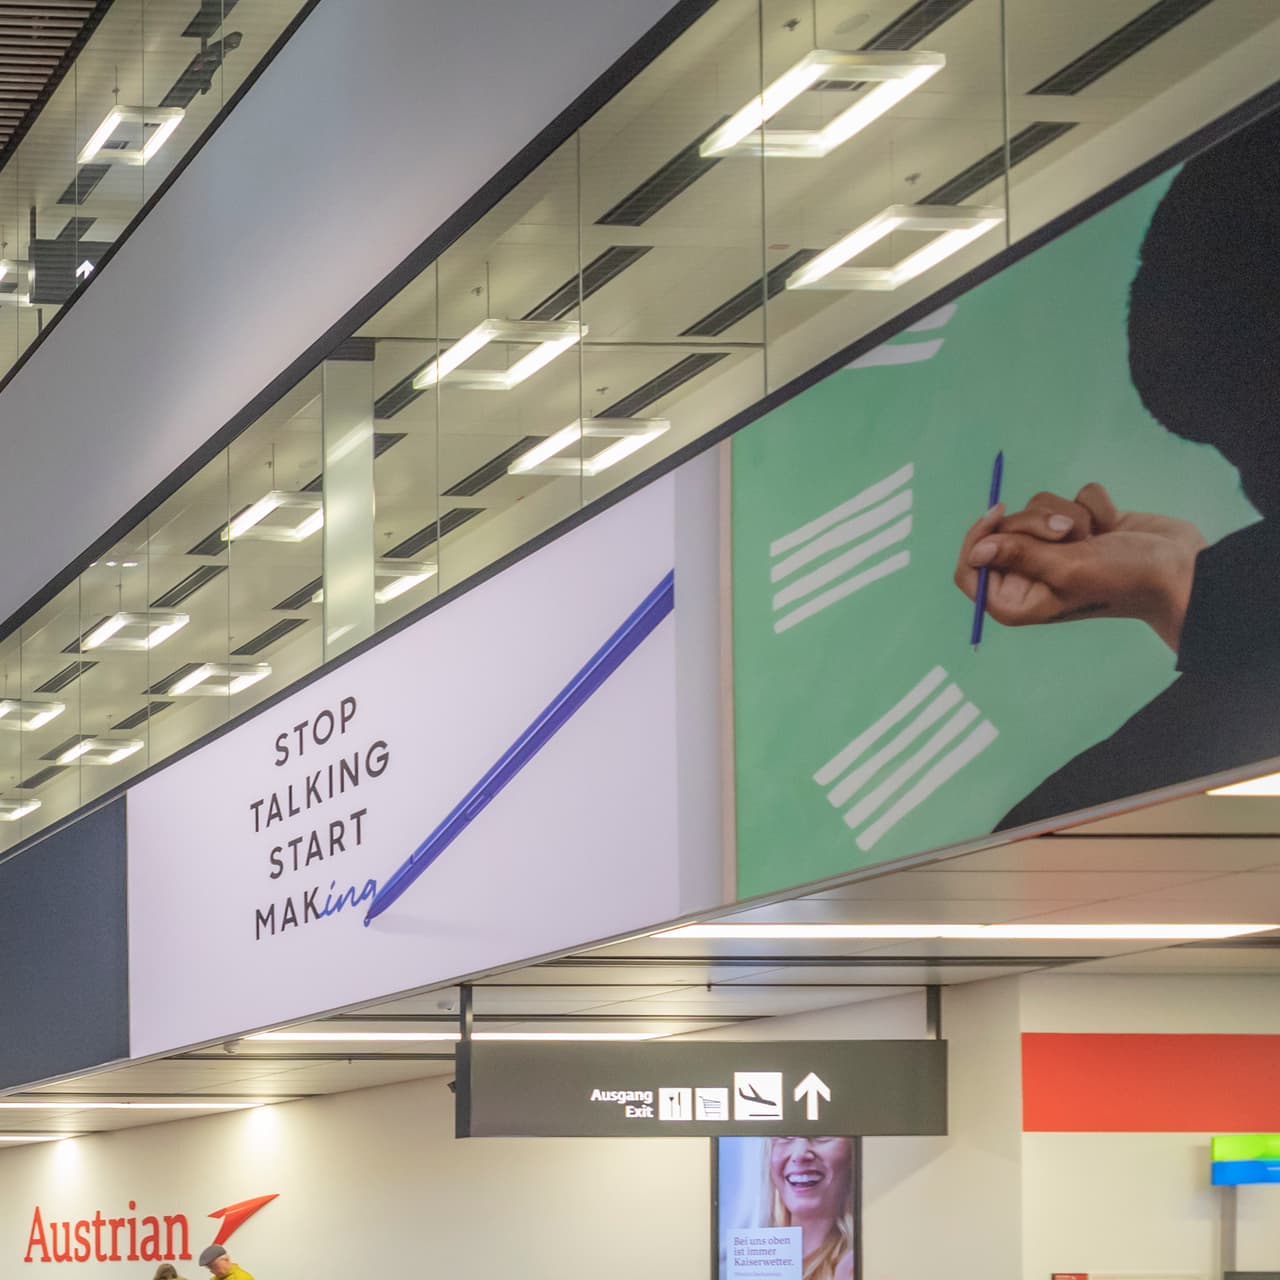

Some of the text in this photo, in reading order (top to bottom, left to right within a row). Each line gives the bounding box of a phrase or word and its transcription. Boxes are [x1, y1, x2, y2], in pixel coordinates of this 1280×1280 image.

[274, 696, 358, 768] STOP
[249, 739, 390, 833] TALKING
[269, 808, 368, 880] START
[590, 1088, 653, 1104] Ausgang
[625, 1104, 654, 1118] Exit
[24, 1200, 192, 1262] Austrian
[734, 1235, 791, 1246] Bei uns oben
